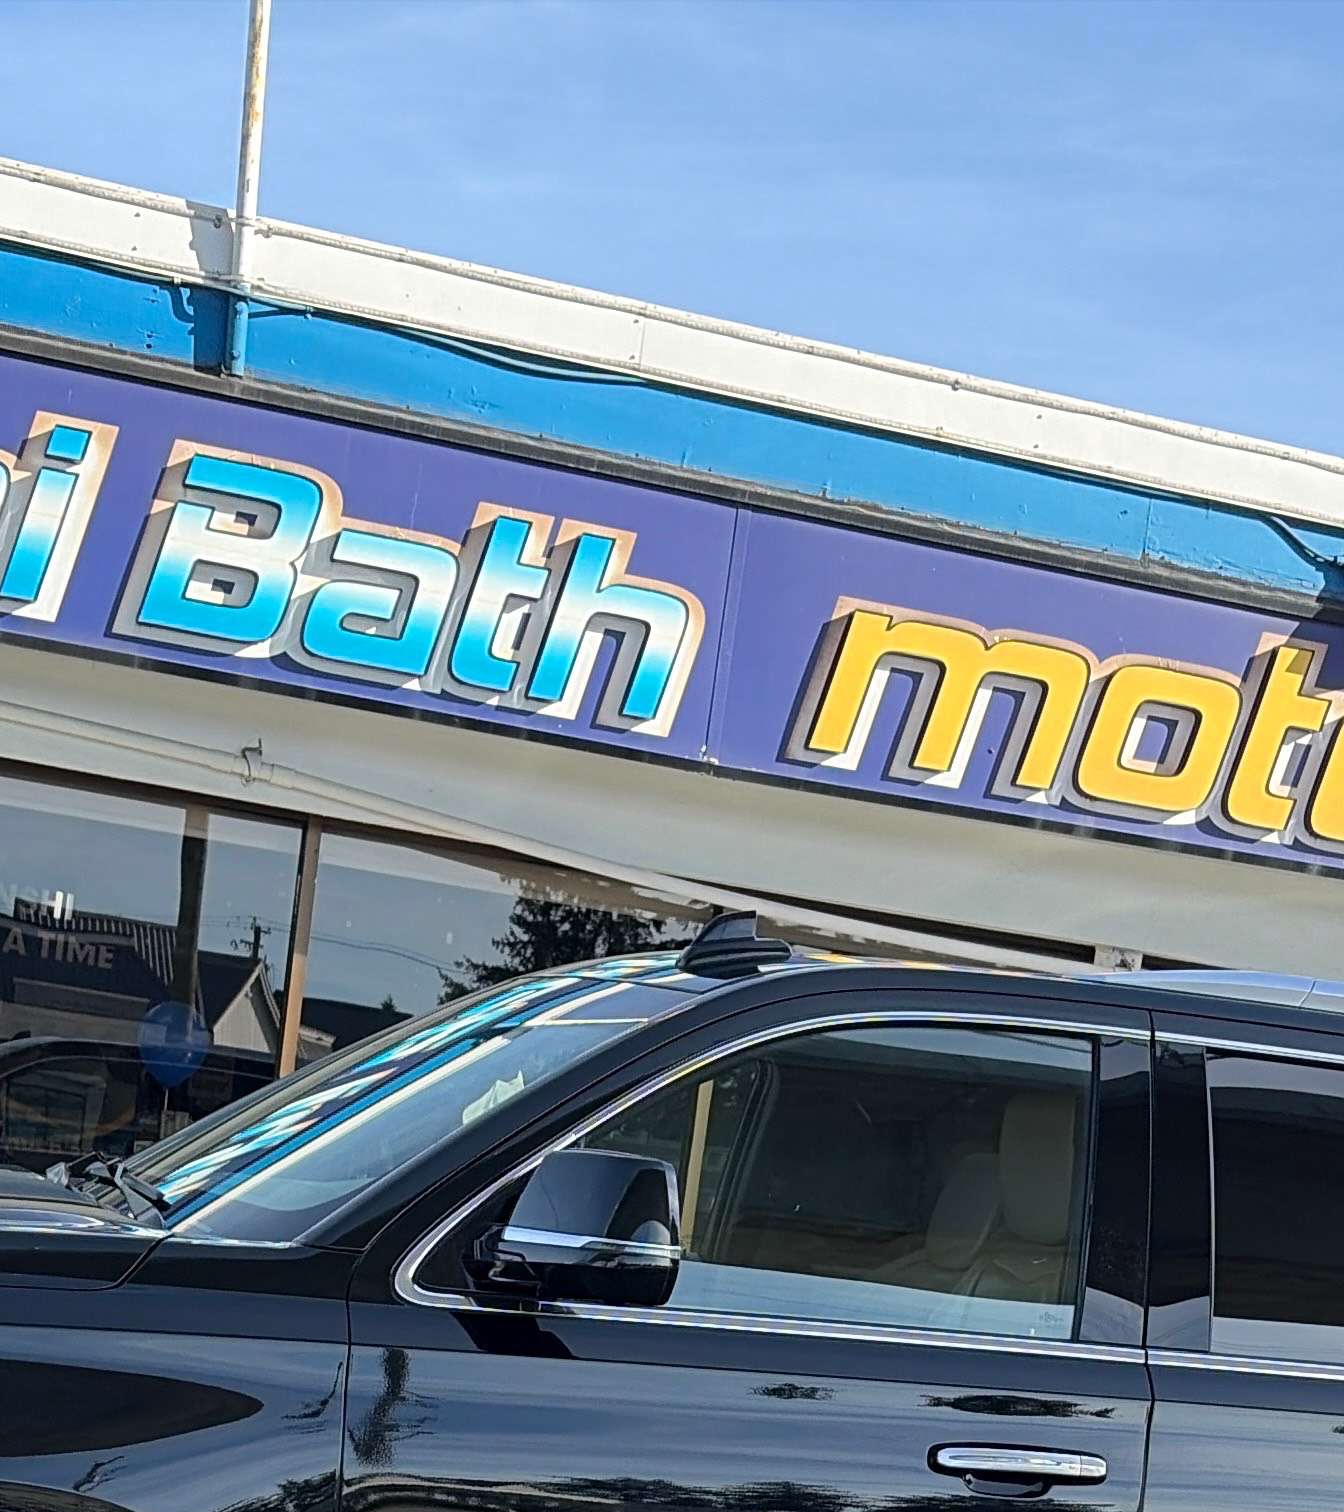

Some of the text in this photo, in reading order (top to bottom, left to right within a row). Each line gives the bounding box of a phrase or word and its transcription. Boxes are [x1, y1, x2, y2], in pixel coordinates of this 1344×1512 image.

[112, 439, 706, 737] Bath
[2, 926, 27, 956] A
[37, 929, 116, 968] TIME
